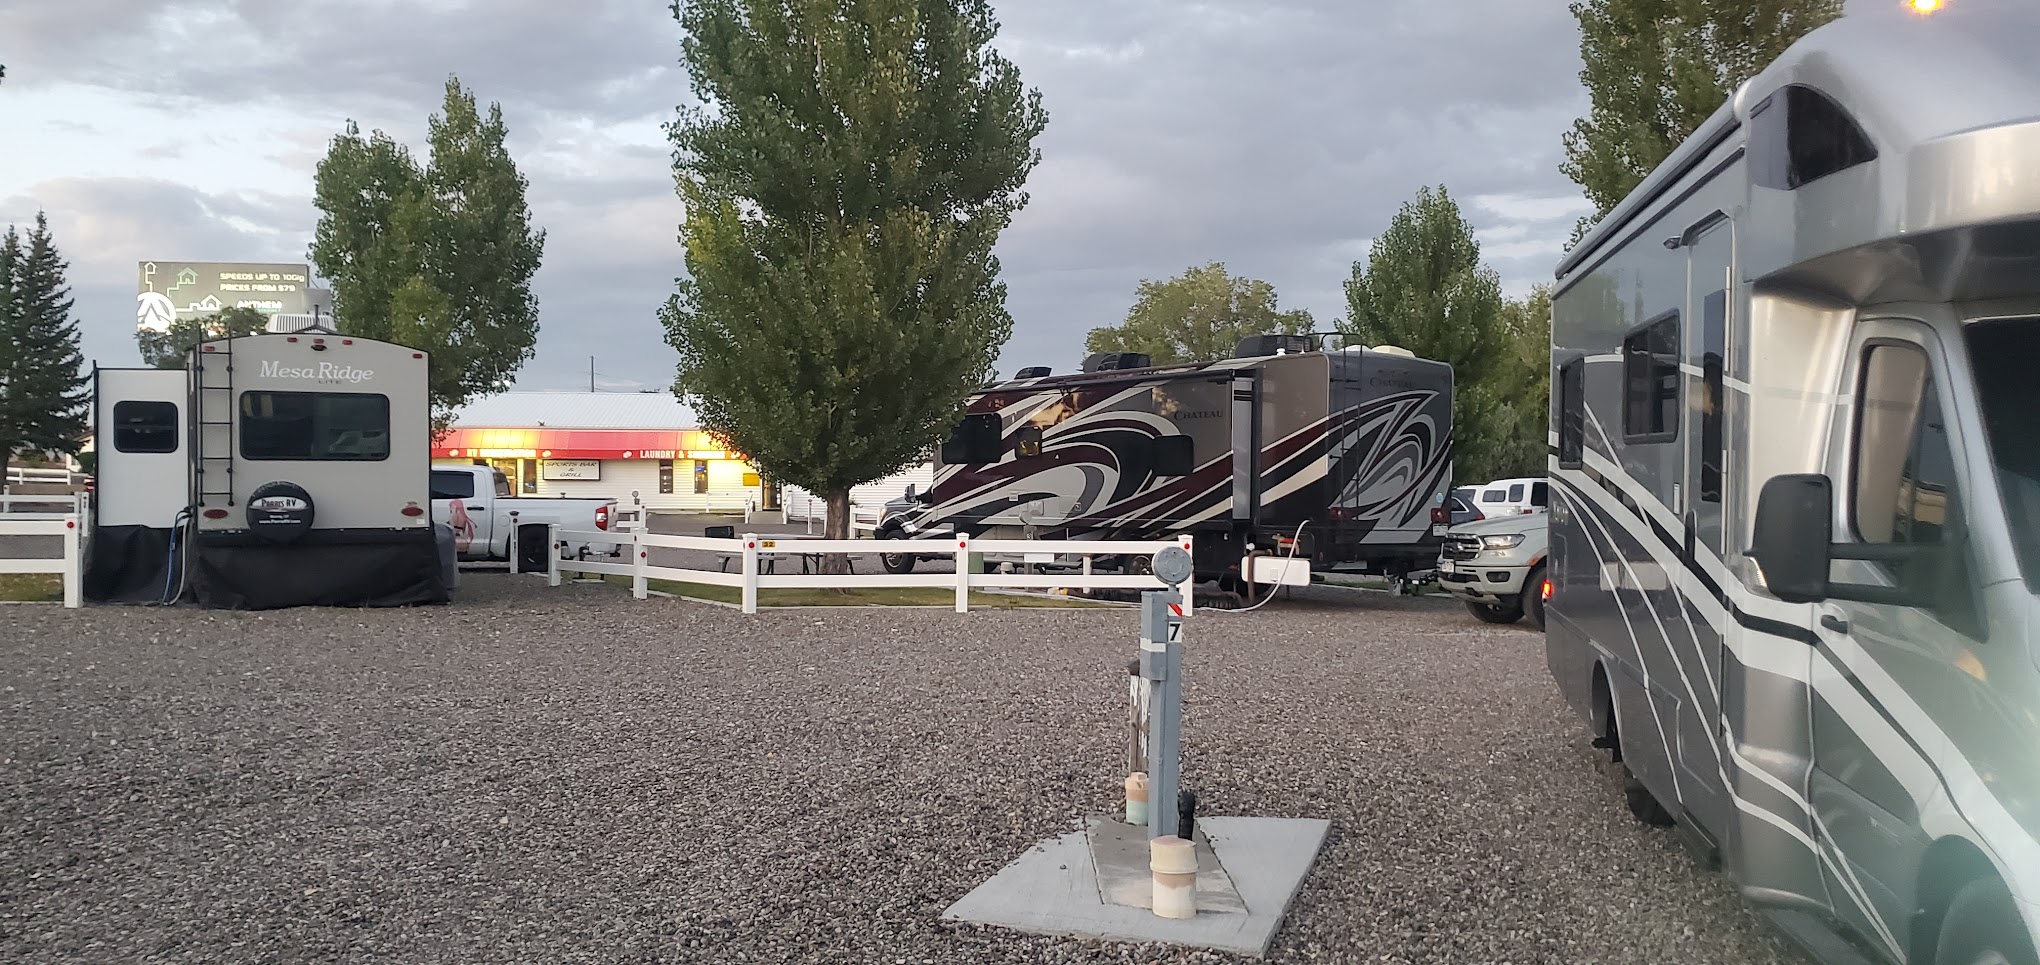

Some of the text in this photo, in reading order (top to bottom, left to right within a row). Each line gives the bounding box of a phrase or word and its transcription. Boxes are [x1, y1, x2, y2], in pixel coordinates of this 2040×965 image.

[219, 272, 253, 280] SPEEDS
[269, 273, 280, 281] TO
[219, 283, 250, 291] PRICES
[251, 283, 277, 291] FROM
[260, 360, 374, 383] Mesa Ridge
[1174, 410, 1224, 421] CHATEAU
[640, 450, 675, 459] LAUNDRY
[678, 450, 685, 459] &
[286, 498, 297, 507] RV
[1169, 623, 1181, 641] 7
